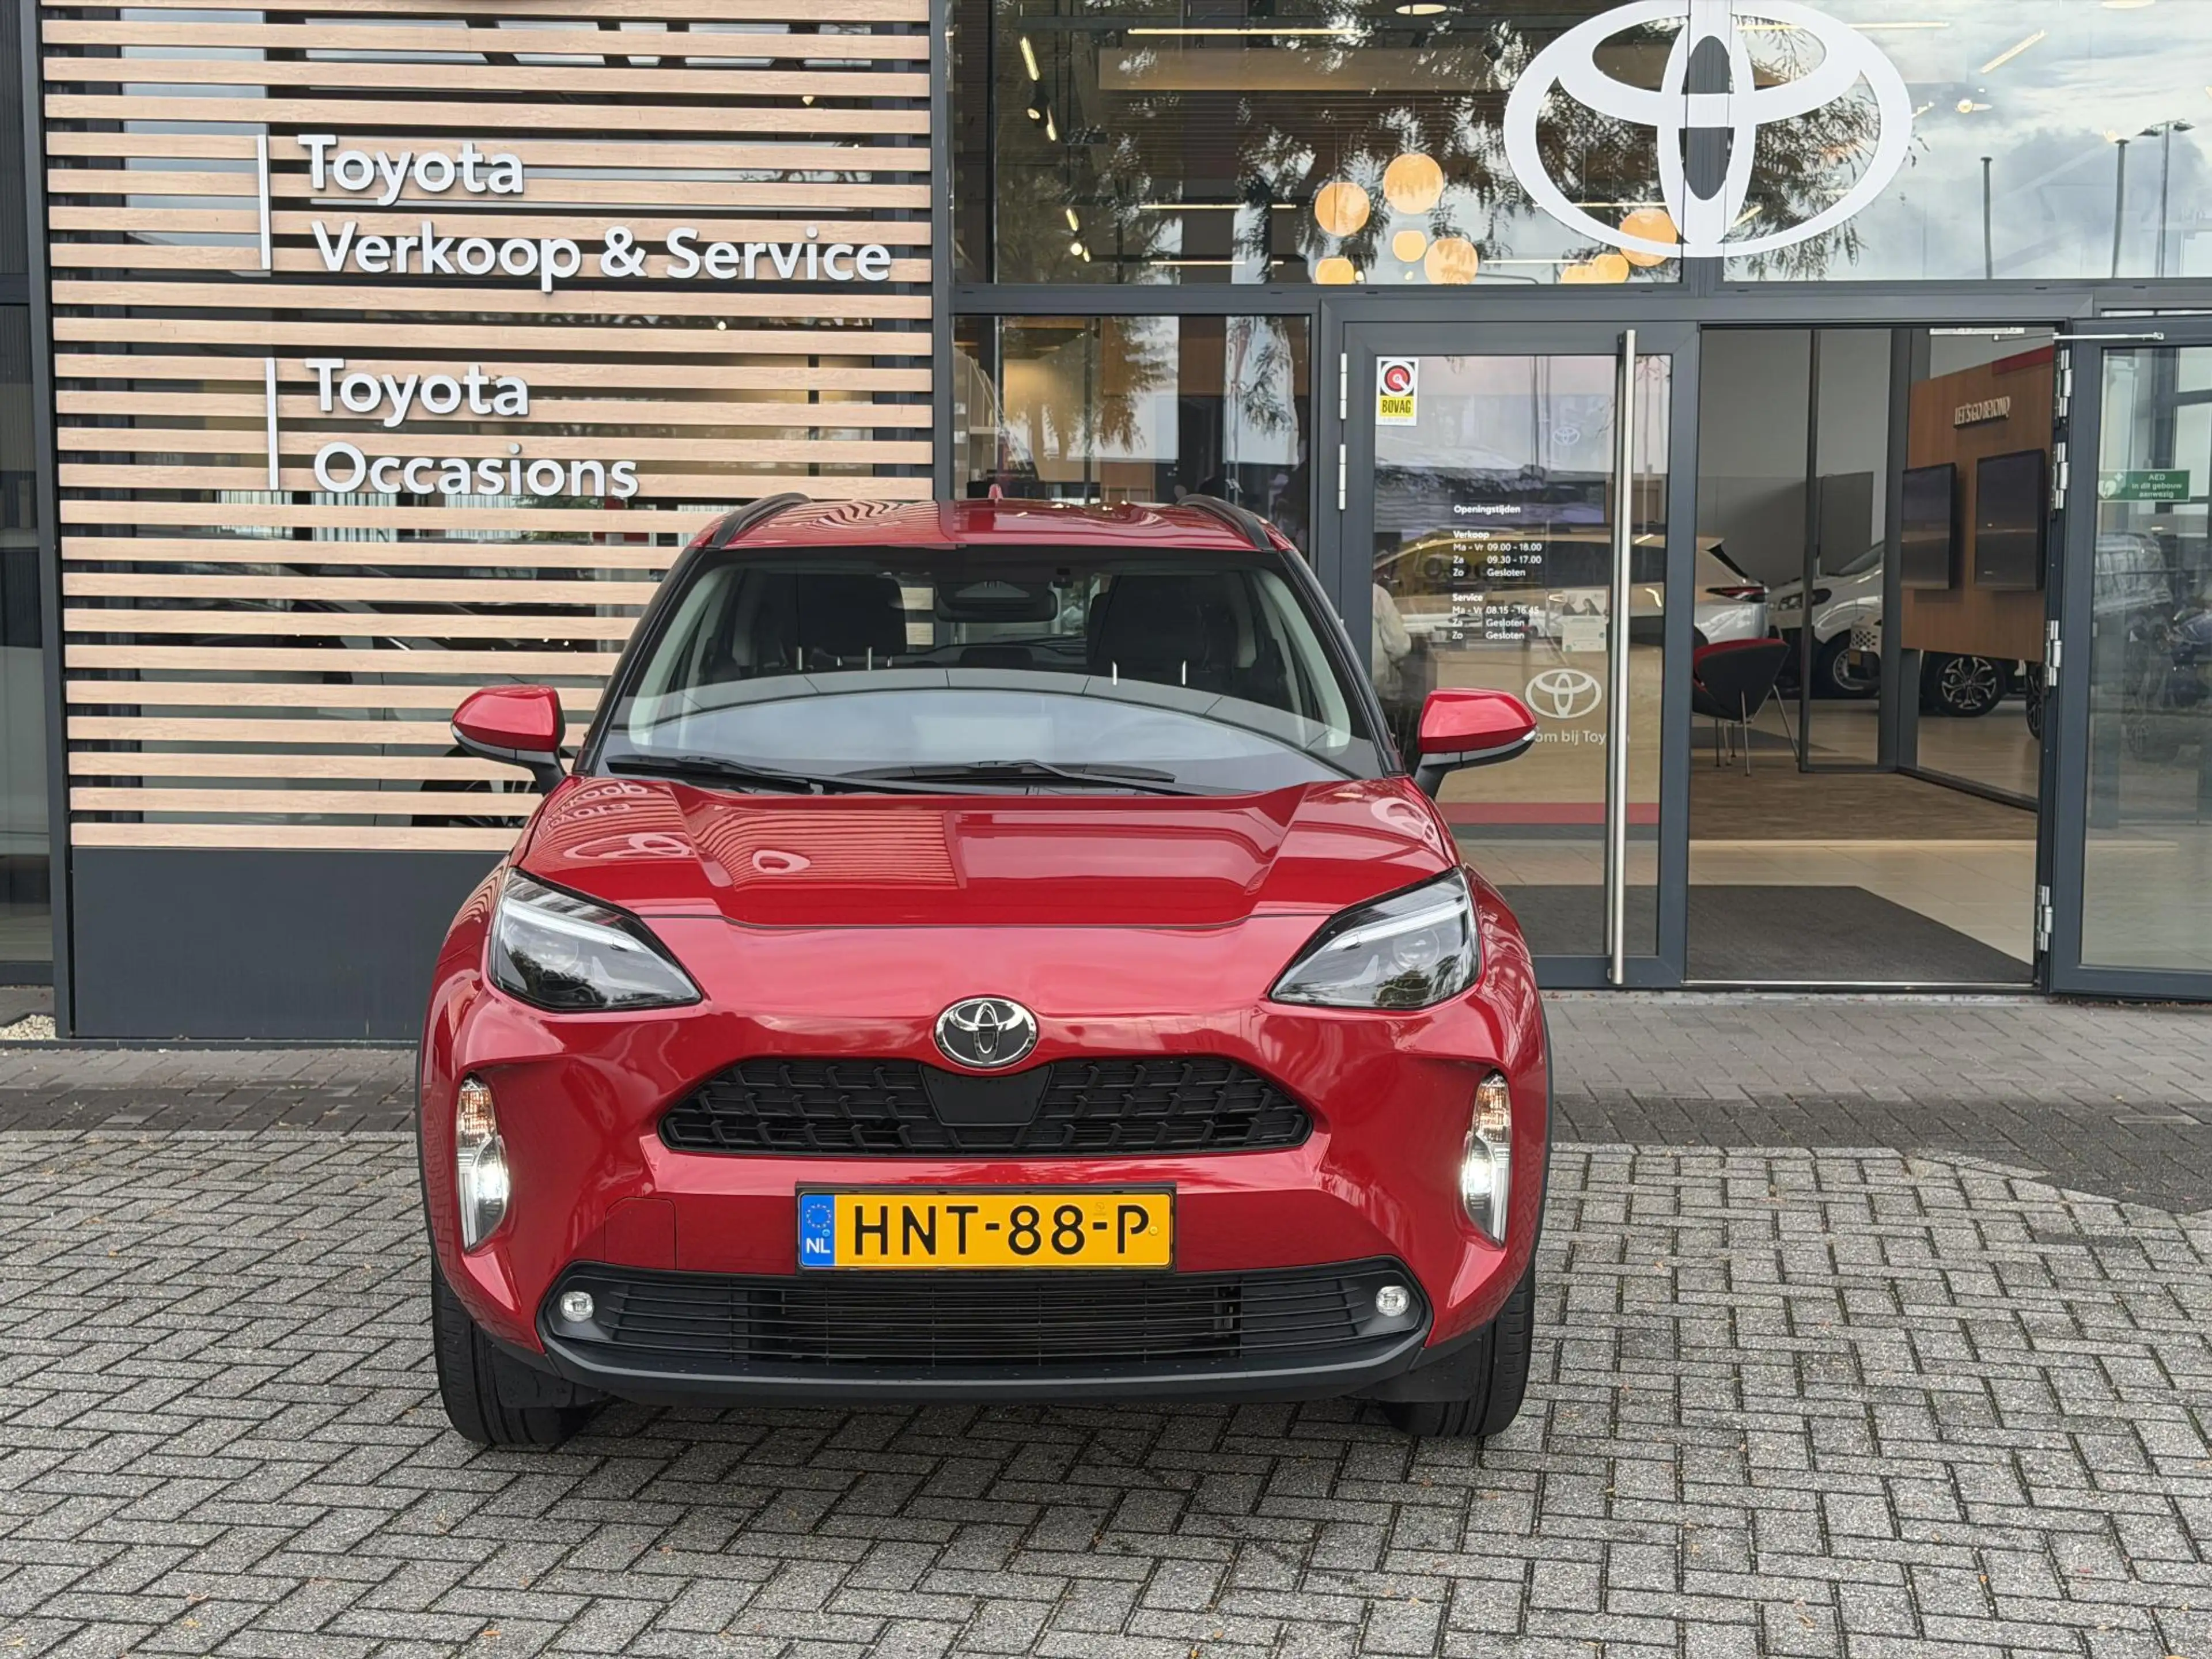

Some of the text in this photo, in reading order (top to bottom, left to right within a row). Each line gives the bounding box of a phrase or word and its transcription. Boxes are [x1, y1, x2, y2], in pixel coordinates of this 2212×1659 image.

[298, 134, 523, 206] Toyota
[312, 221, 891, 293] Verkoop & Service
[305, 358, 528, 427] Toyota
[1382, 399, 1411, 413] BOVAG
[314, 442, 639, 497] Occasions
[1453, 505, 1521, 515] Openingstijden
[1453, 531, 1490, 540] Verkoop
[1453, 543, 1467, 551] Ma
[1475, 543, 1484, 551] Vr
[1487, 543, 1511, 551] 09.00
[1453, 555, 1464, 564] Za
[1487, 555, 1511, 564] 09.30
[1520, 555, 1542, 564] 17.00
[1453, 568, 1526, 577] Zo Gesloten
[1452, 593, 1483, 601] Service
[1452, 606, 1465, 614] Ma
[1486, 606, 1509, 614] 08.15
[1486, 618, 1525, 627] Gesloten
[1452, 631, 1525, 639] Zo Gesloten
[1561, 729, 1578, 745] bij
[806, 1237, 831, 1253] NL
[855, 1205, 1149, 1256] HNT-88-P
